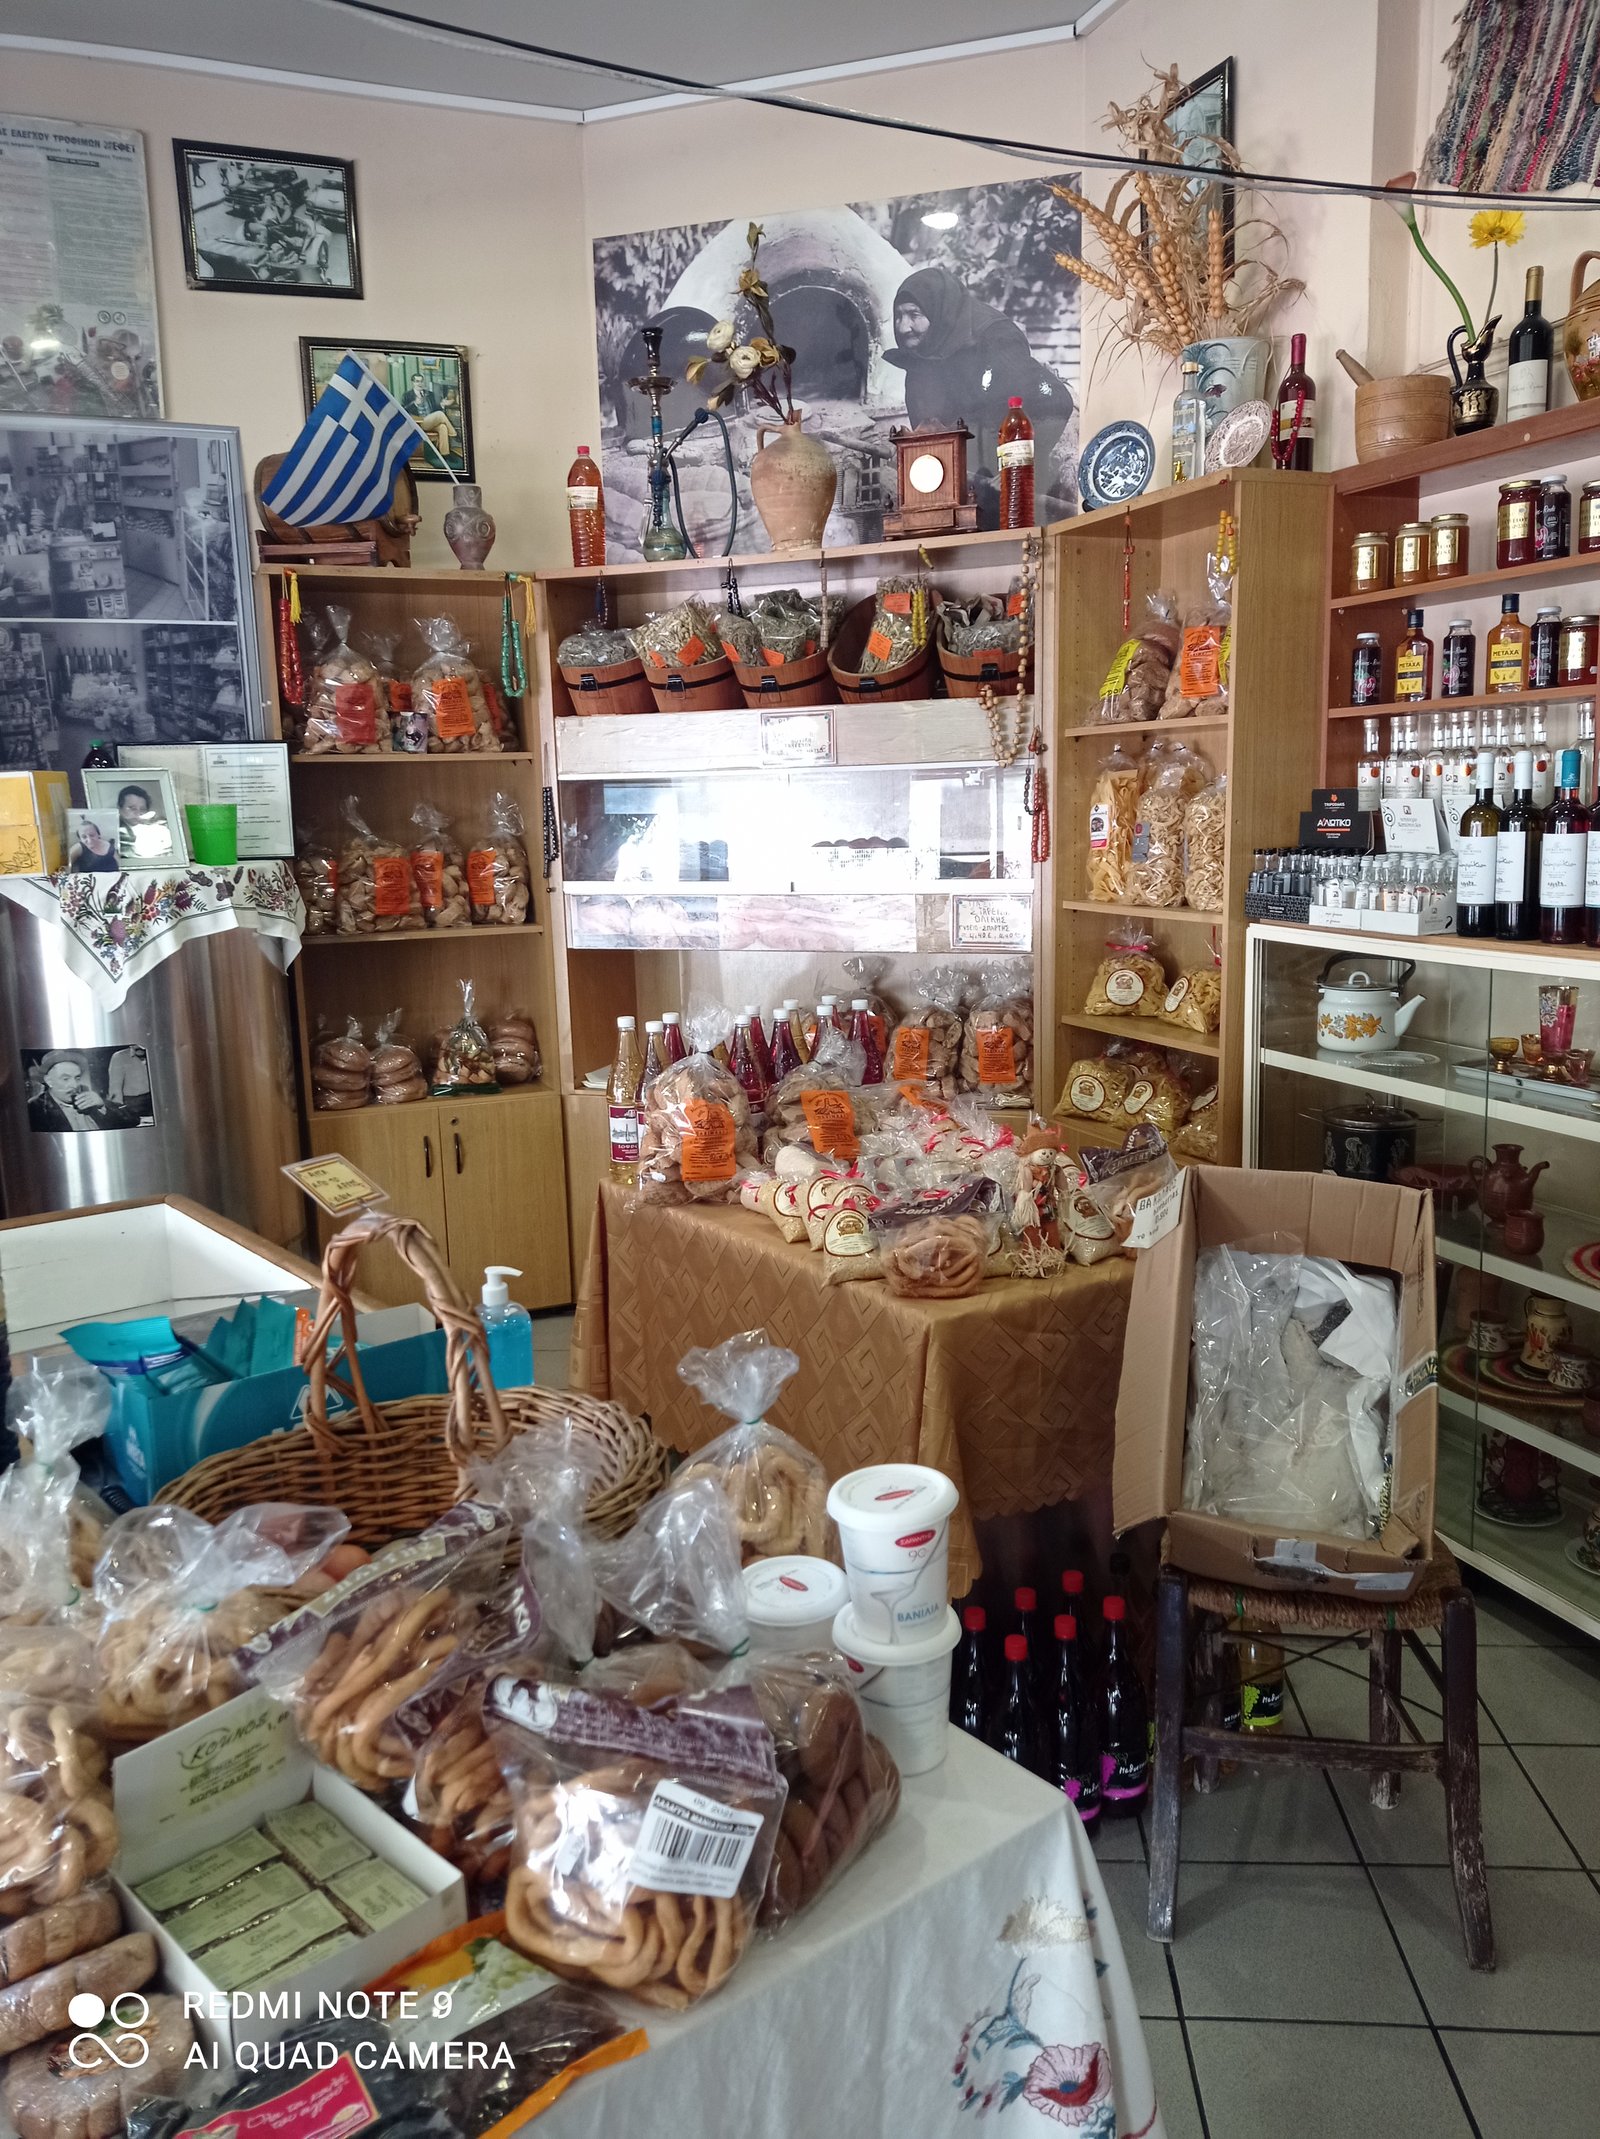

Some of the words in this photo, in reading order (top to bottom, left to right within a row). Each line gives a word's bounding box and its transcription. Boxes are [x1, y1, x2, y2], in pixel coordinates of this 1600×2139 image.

[11, 129, 49, 141] ΕΛΕΓΧΟΥ
[53, 134, 100, 148] ΤΡΟΦΙΜΩΝ
[897, 1603, 939, 1622] ΒΑΝΙΛΙΑ
